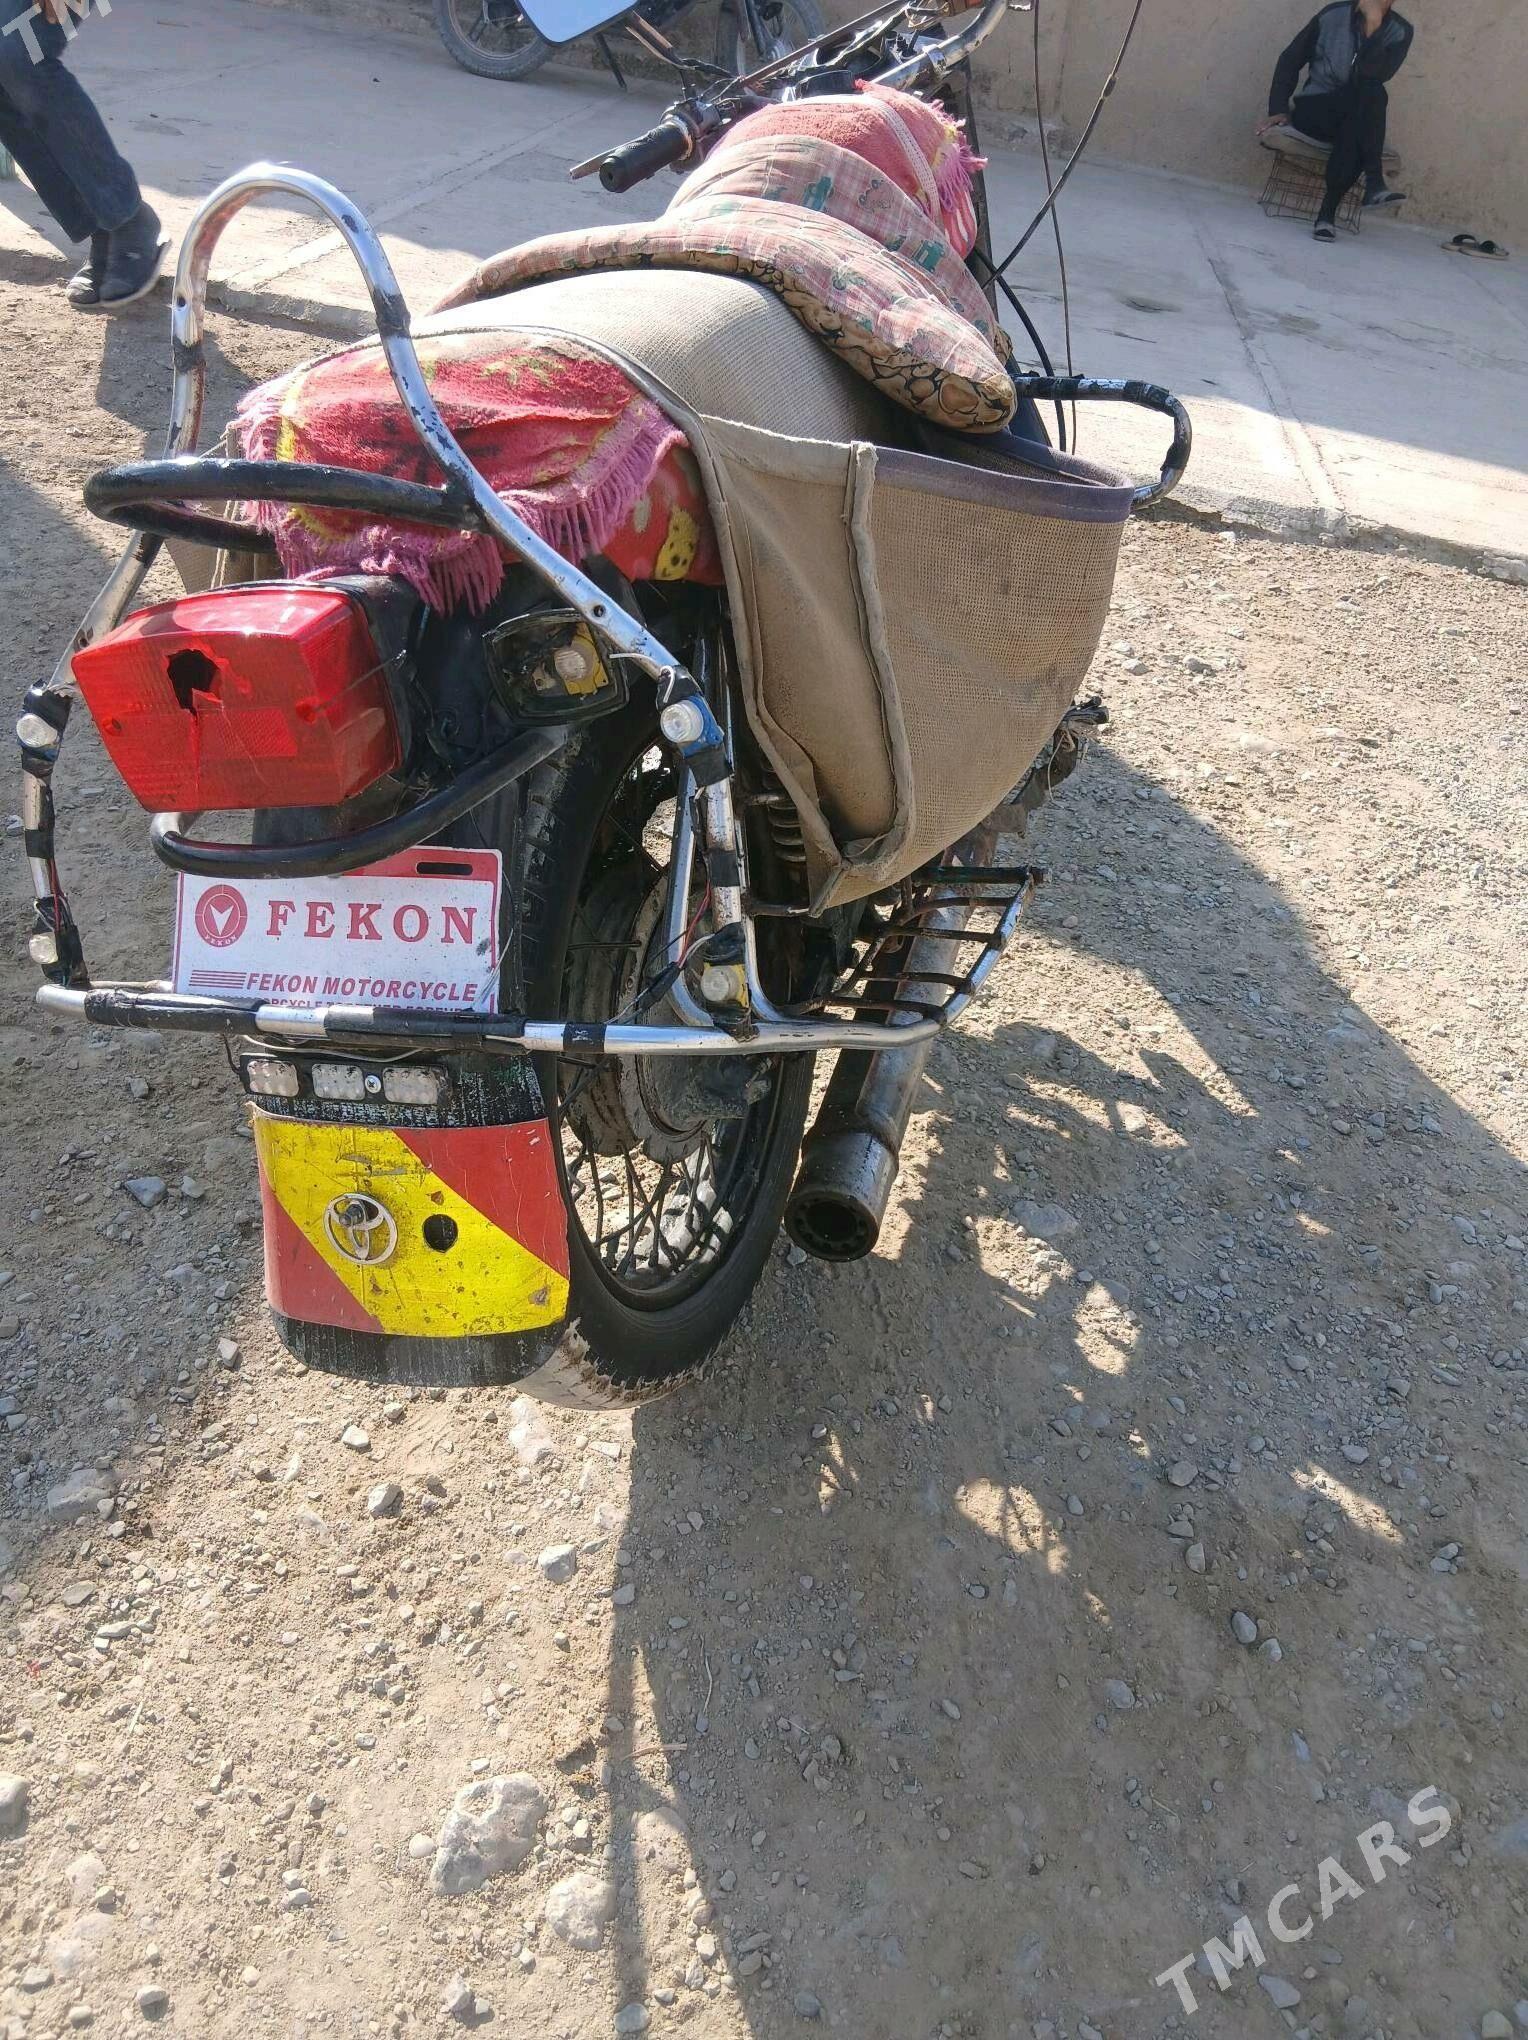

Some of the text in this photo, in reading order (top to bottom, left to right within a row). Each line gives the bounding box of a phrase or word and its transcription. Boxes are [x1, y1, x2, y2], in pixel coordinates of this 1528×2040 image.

[266, 899, 478, 945] FEKON
[246, 972, 479, 1002] FEKON MOTORCYCLE
